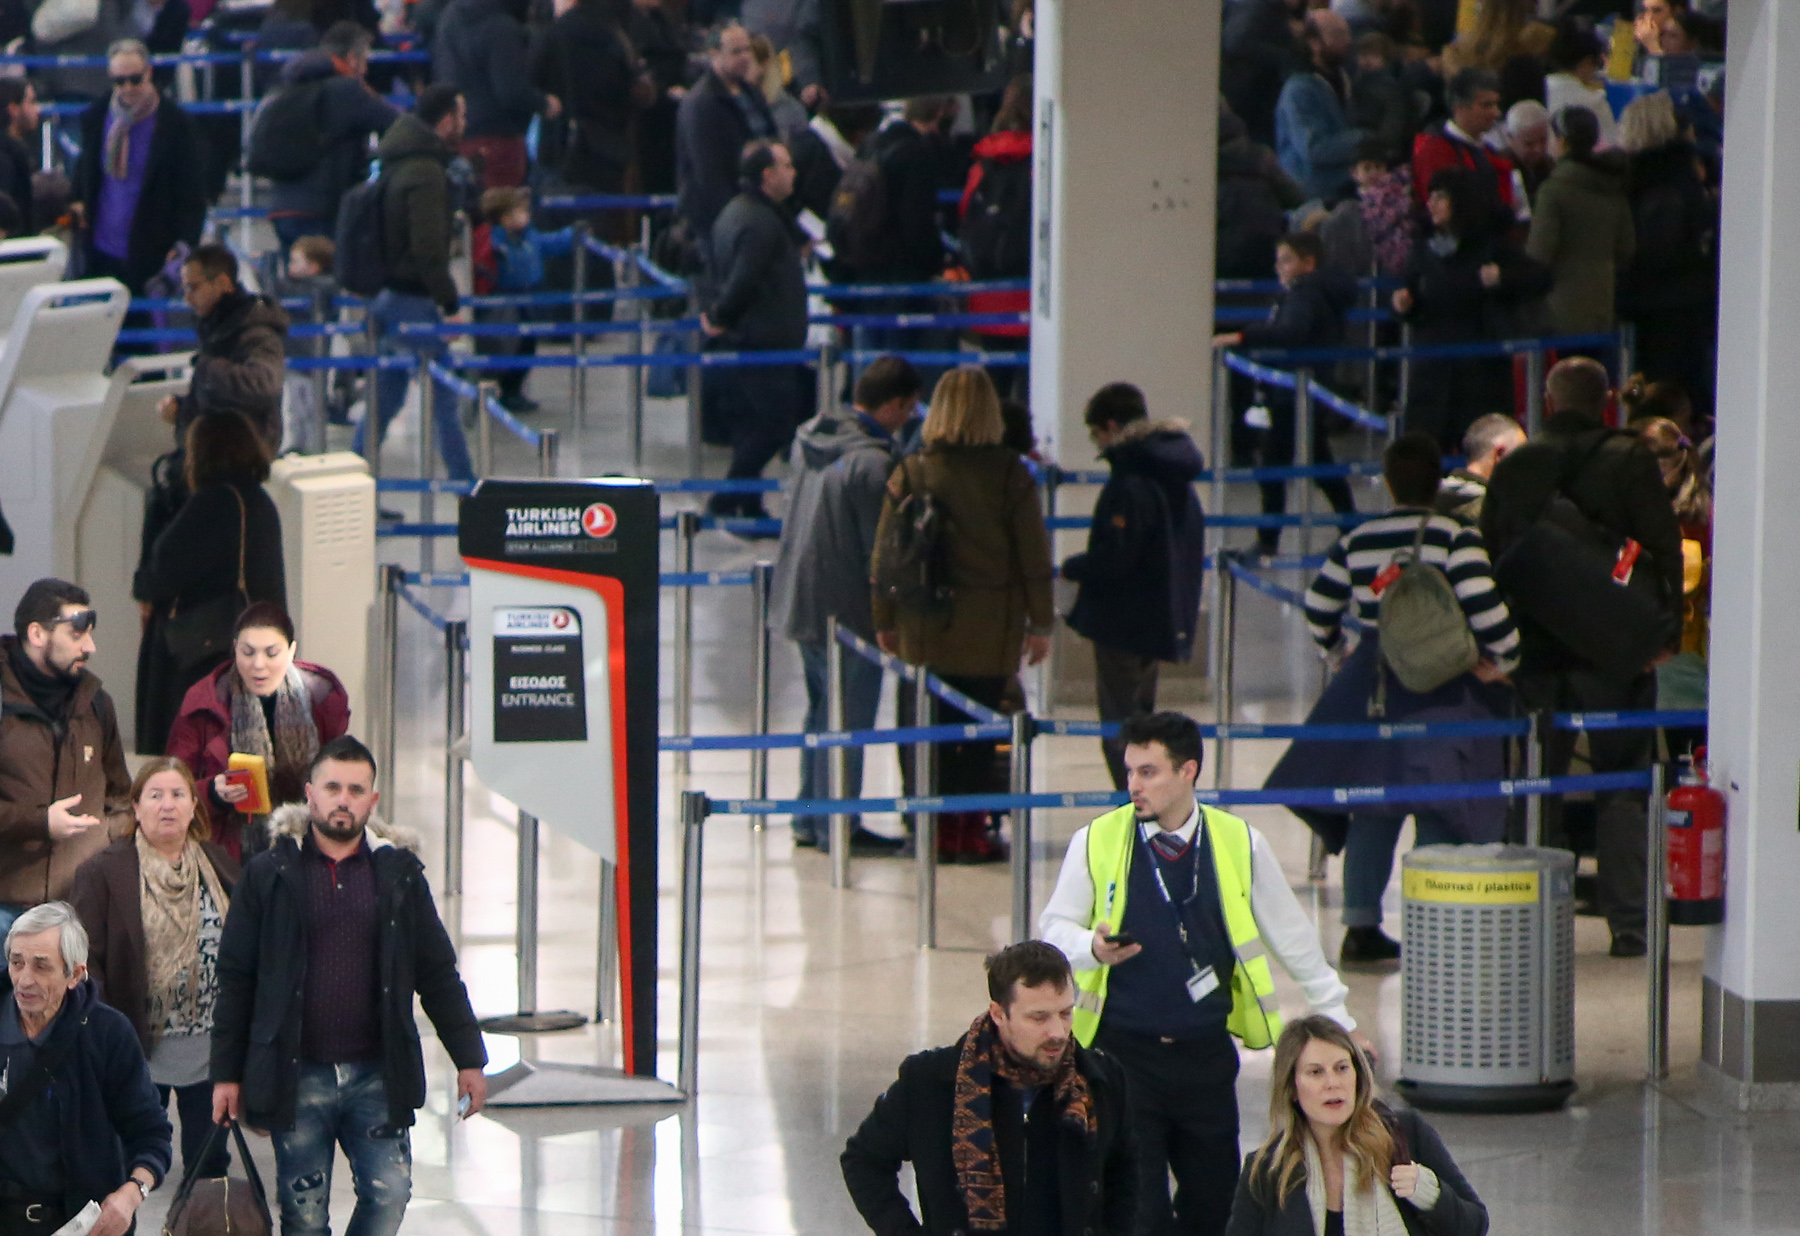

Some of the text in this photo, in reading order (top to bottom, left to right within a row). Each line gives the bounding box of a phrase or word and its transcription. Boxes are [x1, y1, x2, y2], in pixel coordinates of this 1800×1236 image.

[506, 507, 580, 521] TURKISH
[505, 521, 580, 536] AIRLINES
[501, 693, 575, 707] ENTRANCE
[1484, 881, 1531, 894] plastics
